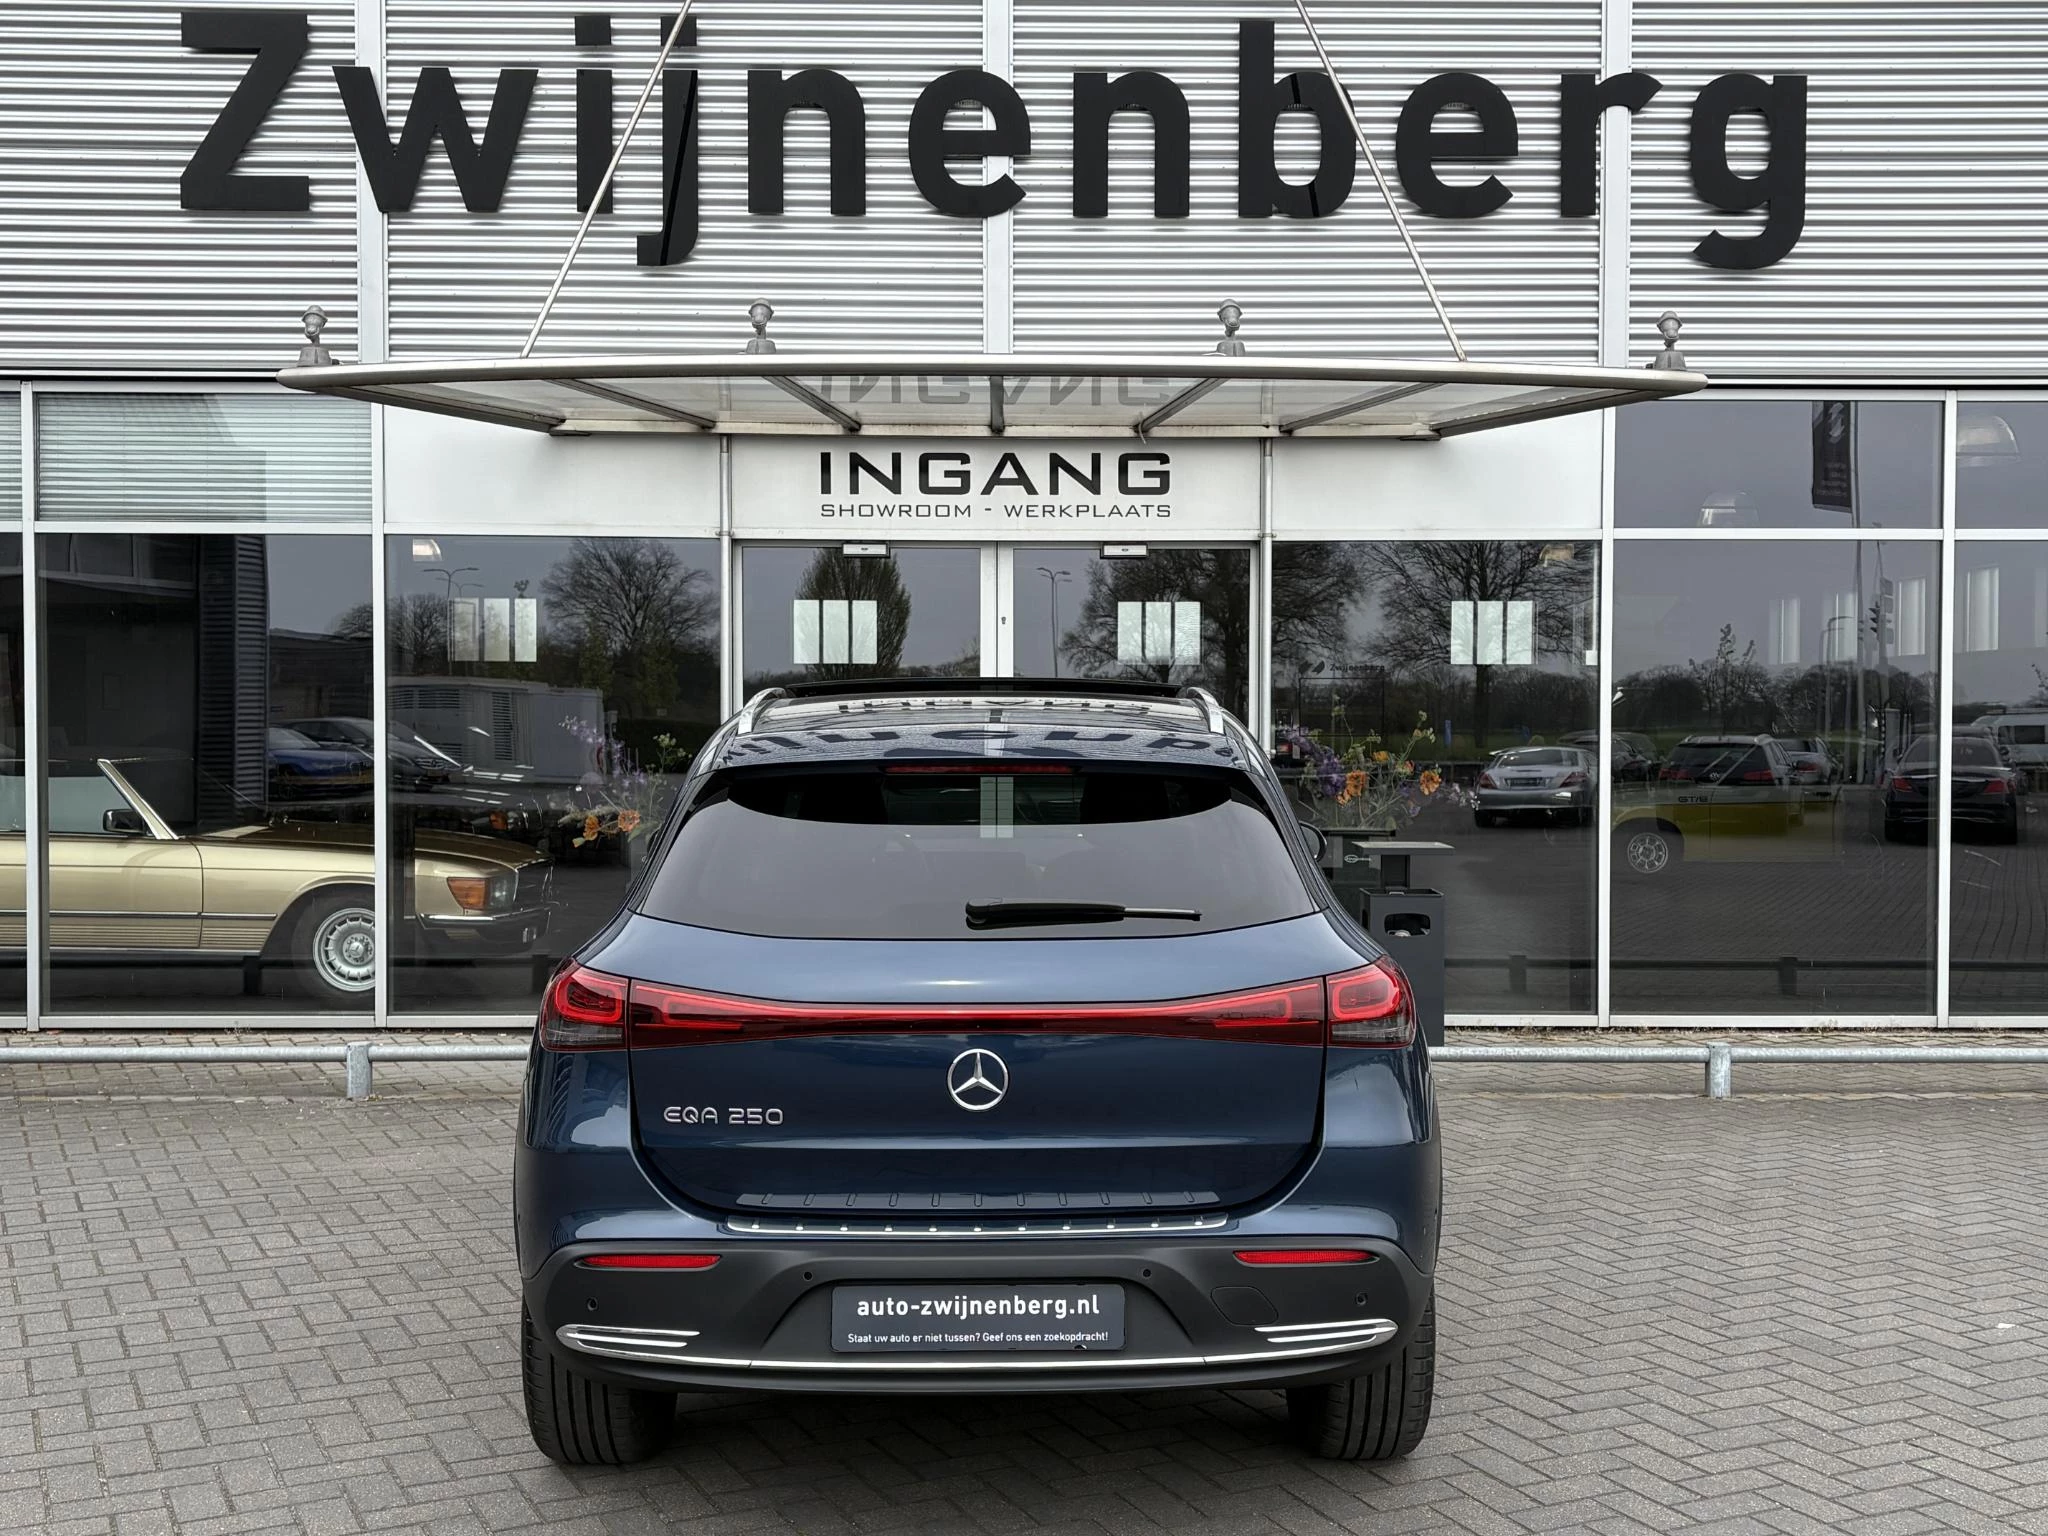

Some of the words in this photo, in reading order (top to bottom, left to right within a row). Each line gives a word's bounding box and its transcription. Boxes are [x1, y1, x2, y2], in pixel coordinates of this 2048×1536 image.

[181, 11, 1808, 270] Zwijnenberg
[820, 452, 1171, 496] INGANG
[820, 503, 972, 518] SHOWROOM
[1004, 503, 1171, 518] WERKPLAATS
[663, 1106, 718, 1125] EQA
[728, 1107, 784, 1125] 250
[856, 1295, 1100, 1320] auto-zwijnenberg.nl
[847, 1333, 872, 1343] Staat
[874, 1335, 888, 1343] uw
[890, 1334, 911, 1343] auto
[912, 1335, 923, 1343] er
[925, 1333, 942, 1343] niet
[944, 1333, 981, 1343] tussen?
[982, 1332, 1004, 1342] Geef
[1006, 1334, 1023, 1342] ons
[1025, 1334, 1042, 1342] een
[1044, 1331, 1109, 1343] zoekopdracht!
